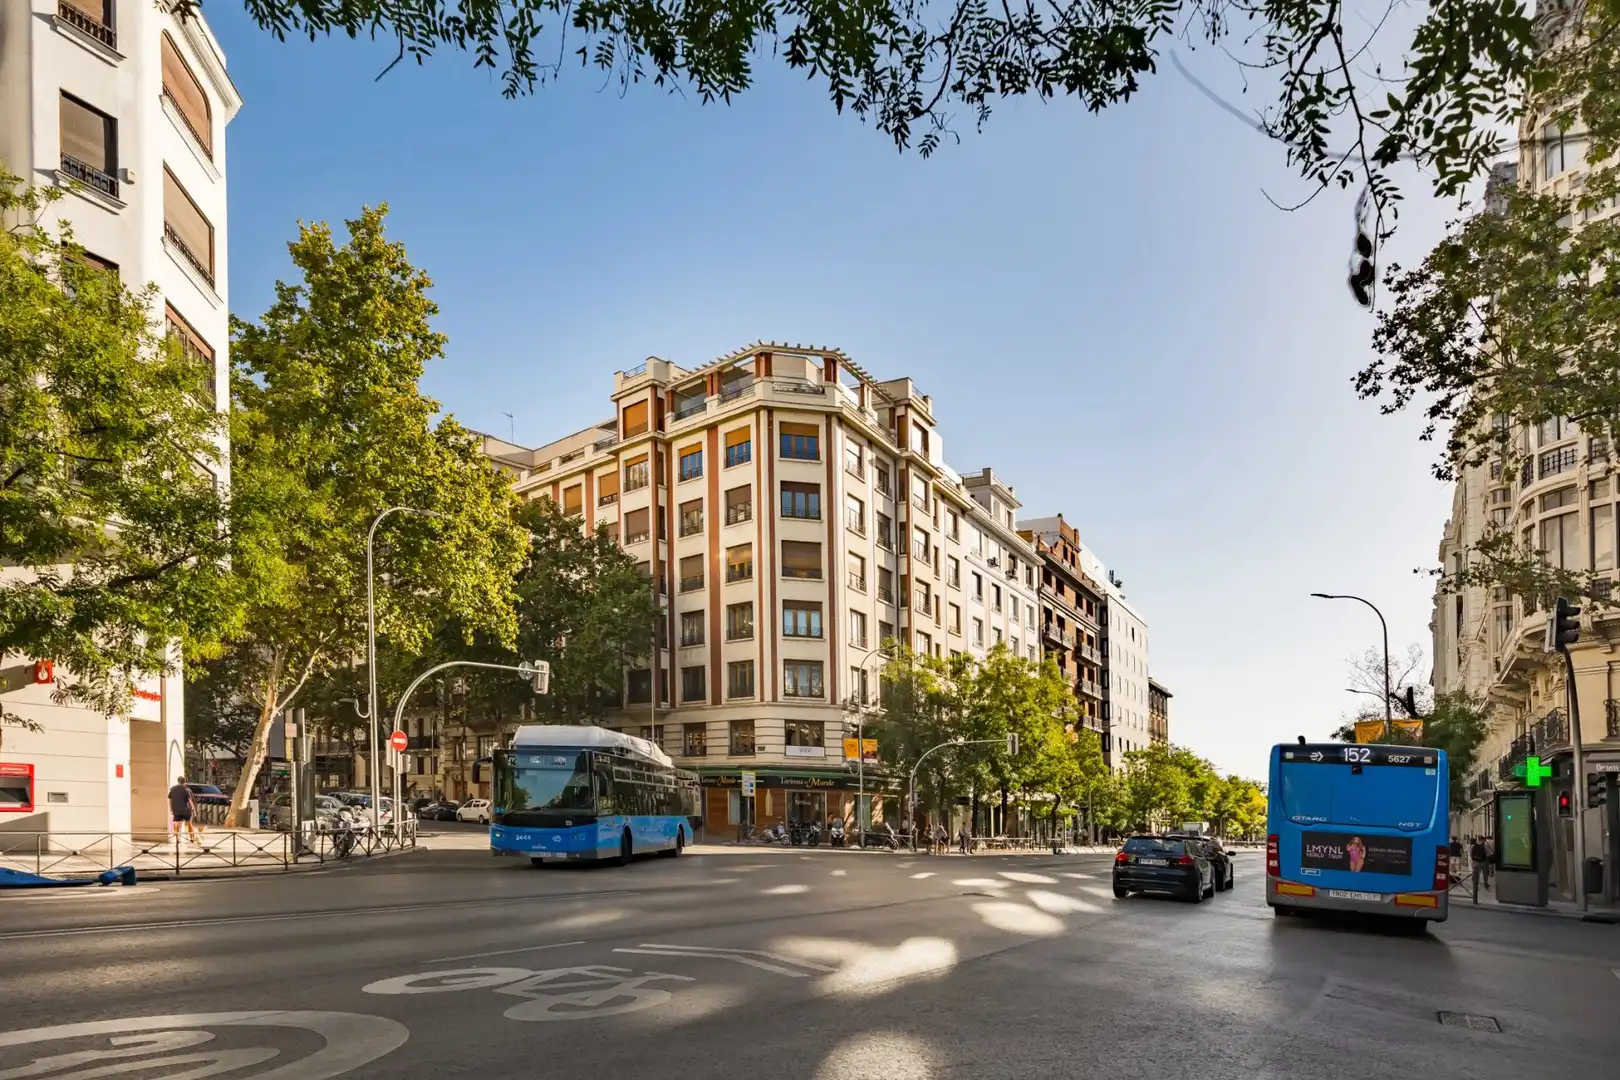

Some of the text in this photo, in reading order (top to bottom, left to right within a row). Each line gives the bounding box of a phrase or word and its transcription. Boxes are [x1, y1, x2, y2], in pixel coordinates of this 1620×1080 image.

[1344, 747, 1411, 763] 152 5627
[1306, 844, 1343, 855] LMYNL
